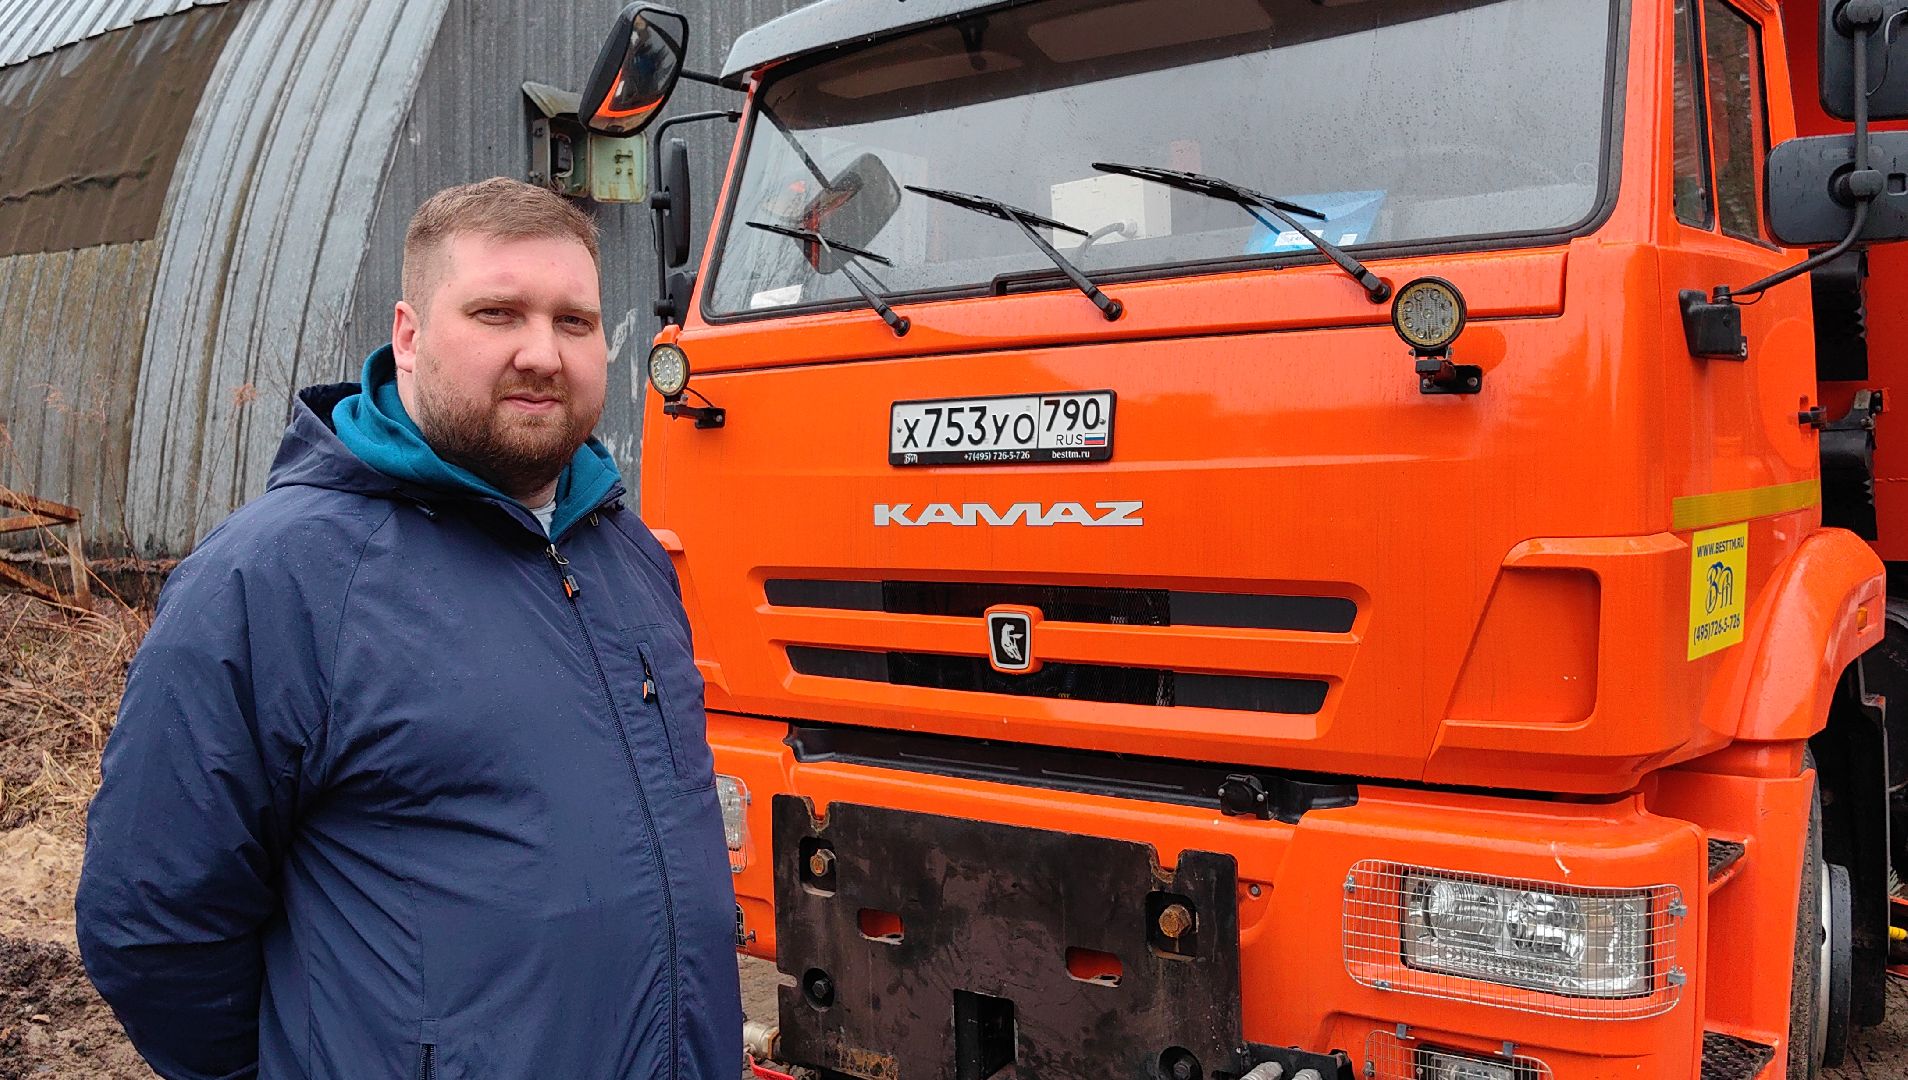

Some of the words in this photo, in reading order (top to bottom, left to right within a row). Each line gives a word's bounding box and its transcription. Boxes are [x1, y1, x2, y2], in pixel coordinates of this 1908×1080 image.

[1043, 397, 1101, 432] 790
[1056, 433, 1083, 446] RUS
[964, 452, 992, 461] +7(495)
[993, 450, 1031, 460] 726-5-726
[1052, 450, 1090, 459] besttm.ru
[874, 500, 1144, 526] KAMAZ
[1697, 536, 1745, 557] WWW.BESTTM.RU
[1693, 613, 1740, 646] (495)726-5-726
